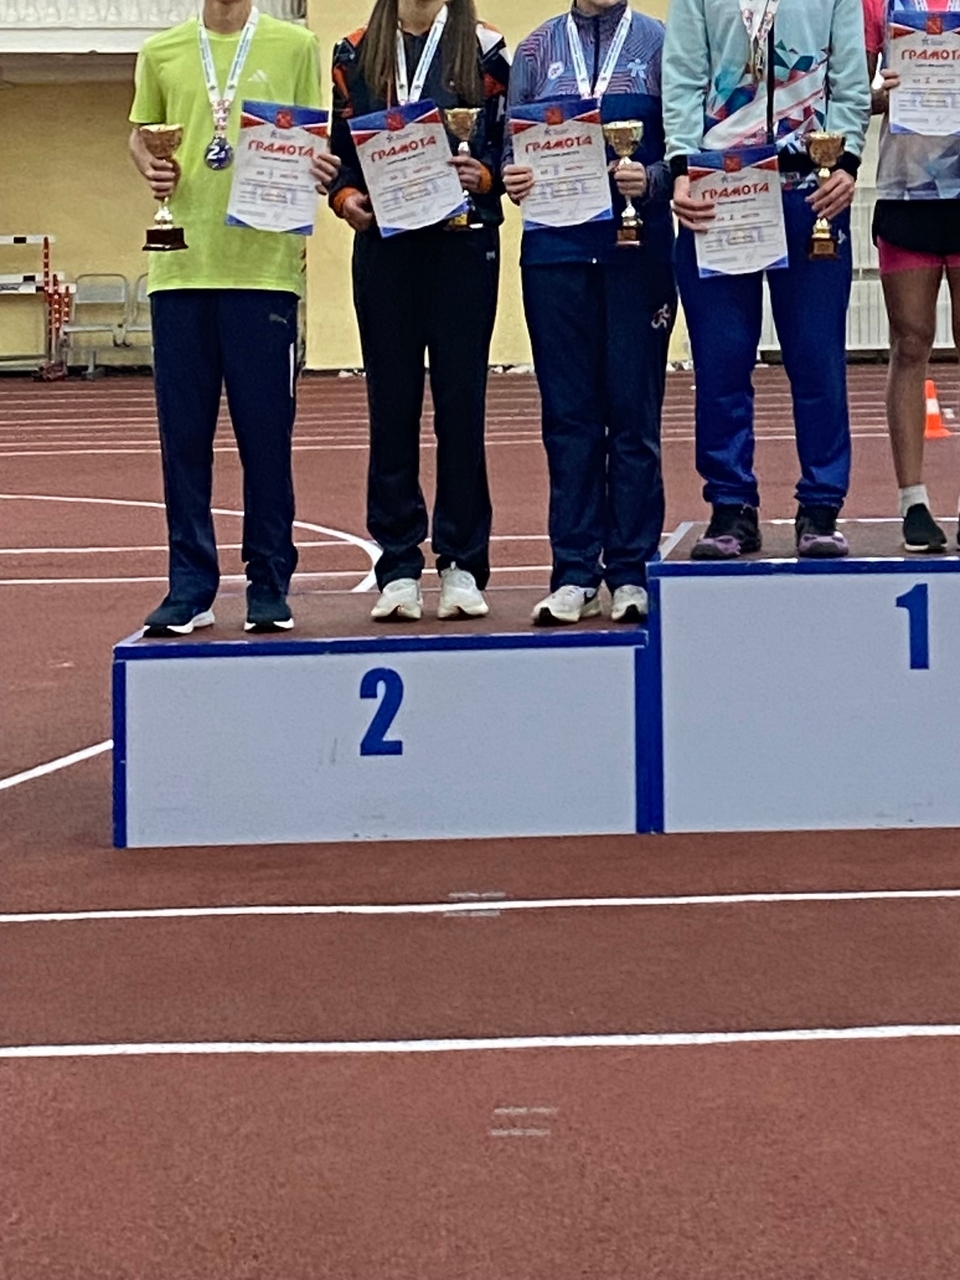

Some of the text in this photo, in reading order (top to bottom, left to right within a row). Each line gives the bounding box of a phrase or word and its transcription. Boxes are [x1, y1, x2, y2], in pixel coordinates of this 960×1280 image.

[248, 140, 315, 158] ГРАМОТА
[371, 135, 437, 162] ГРАМОТА
[525, 135, 593, 154] ГРАМОТА
[701, 182, 769, 200] ГРАМОТА
[895, 583, 929, 670] 1
[359, 667, 404, 757] 2
